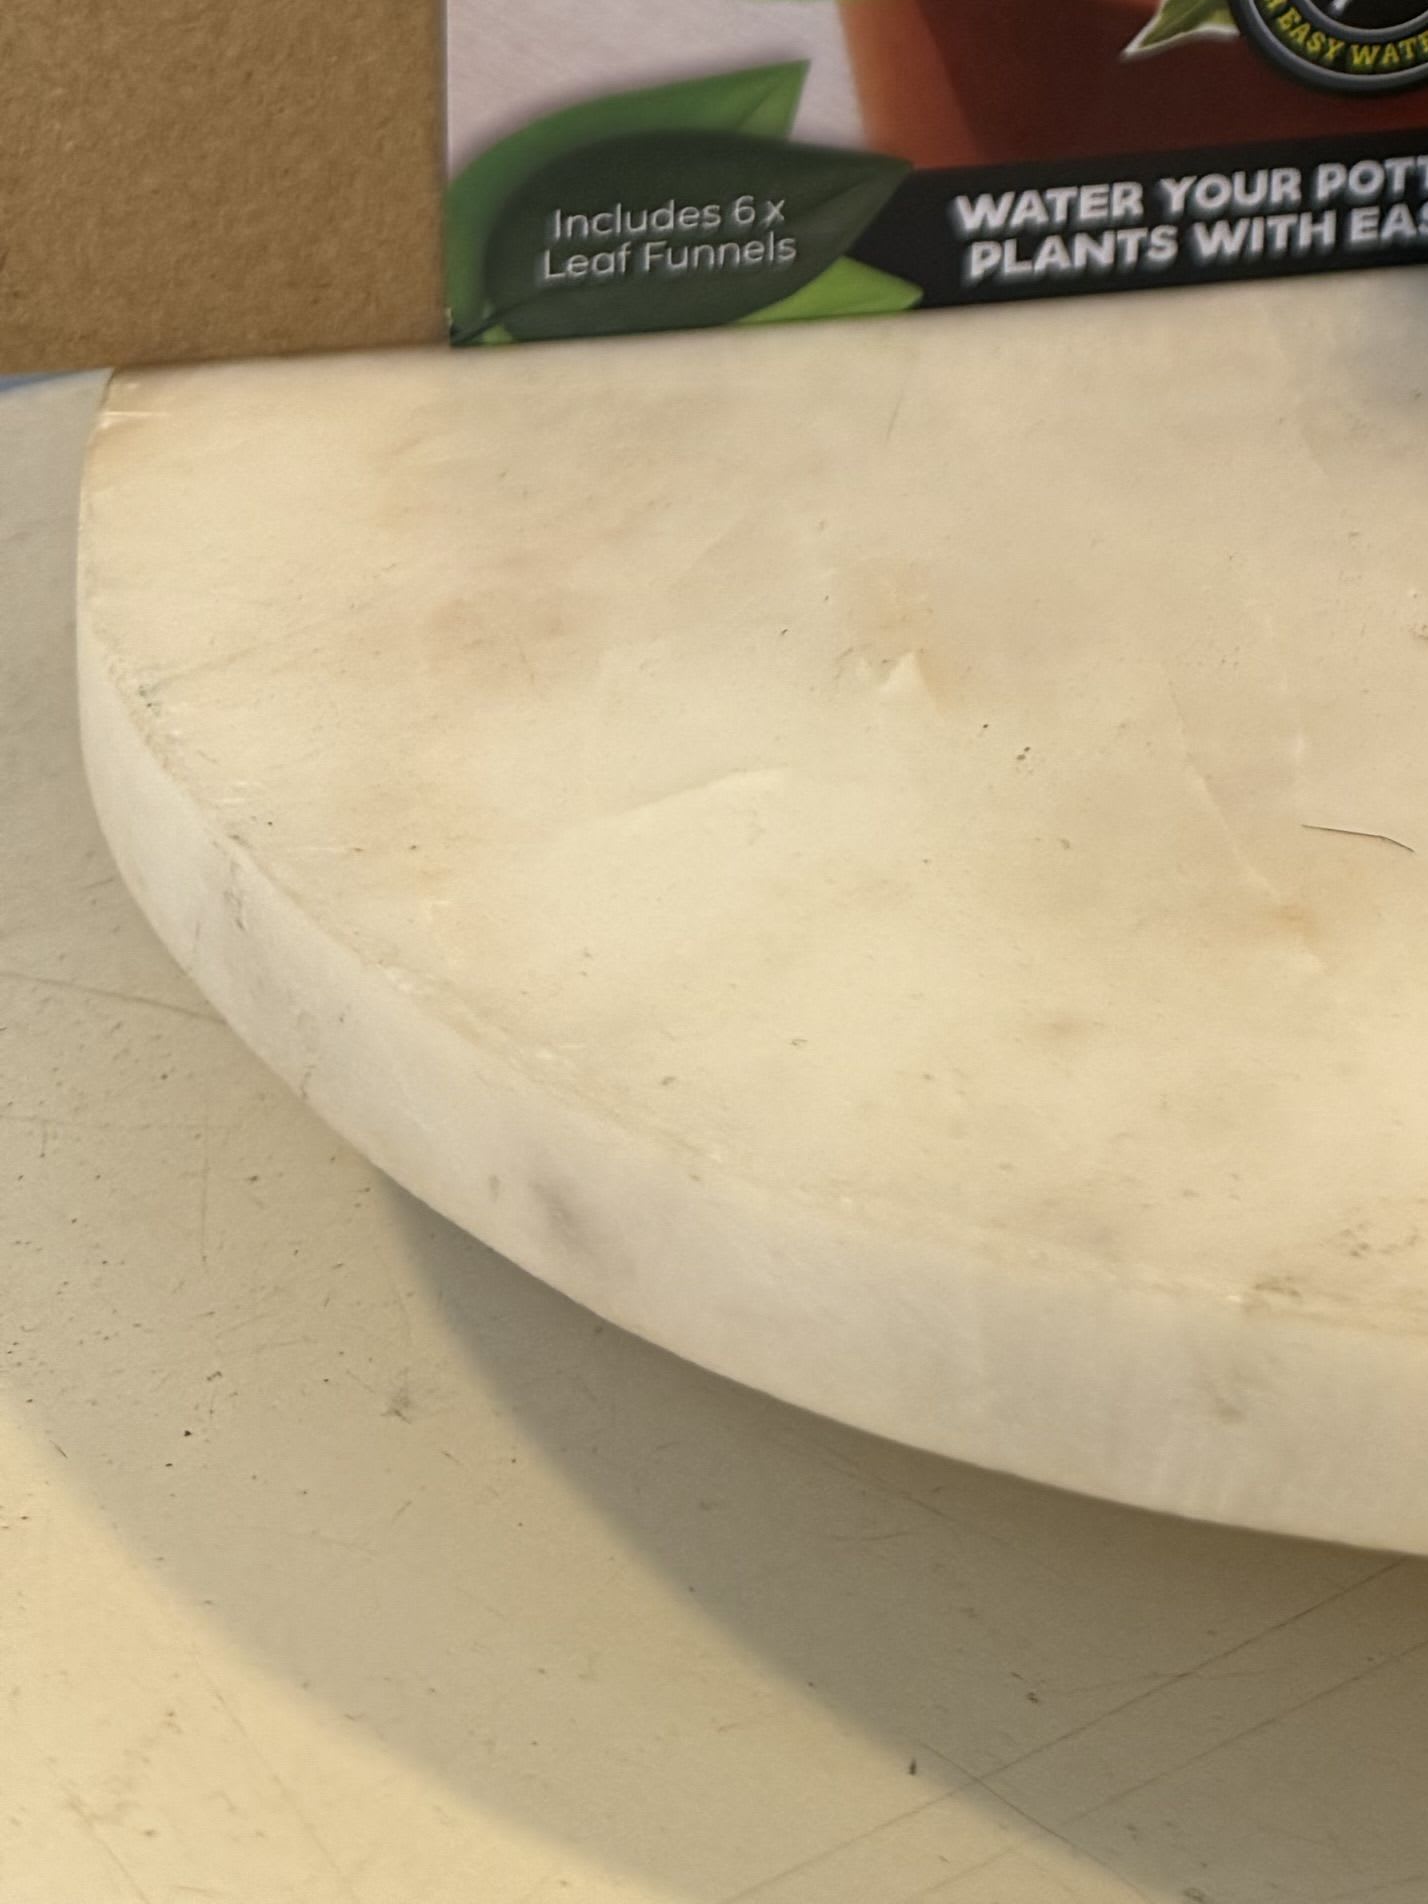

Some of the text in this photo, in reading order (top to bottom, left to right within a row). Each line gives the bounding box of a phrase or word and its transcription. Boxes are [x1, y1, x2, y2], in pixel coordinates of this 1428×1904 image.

[1278, 8, 1346, 62] EASY
[553, 194, 785, 241] Includes 6 x
[955, 181, 1144, 234] WATER
[1161, 166, 1302, 214] YOUR
[543, 230, 798, 280] Leaf Funnels
[966, 224, 1179, 280] PLANTS
[1194, 212, 1336, 260] WITH
